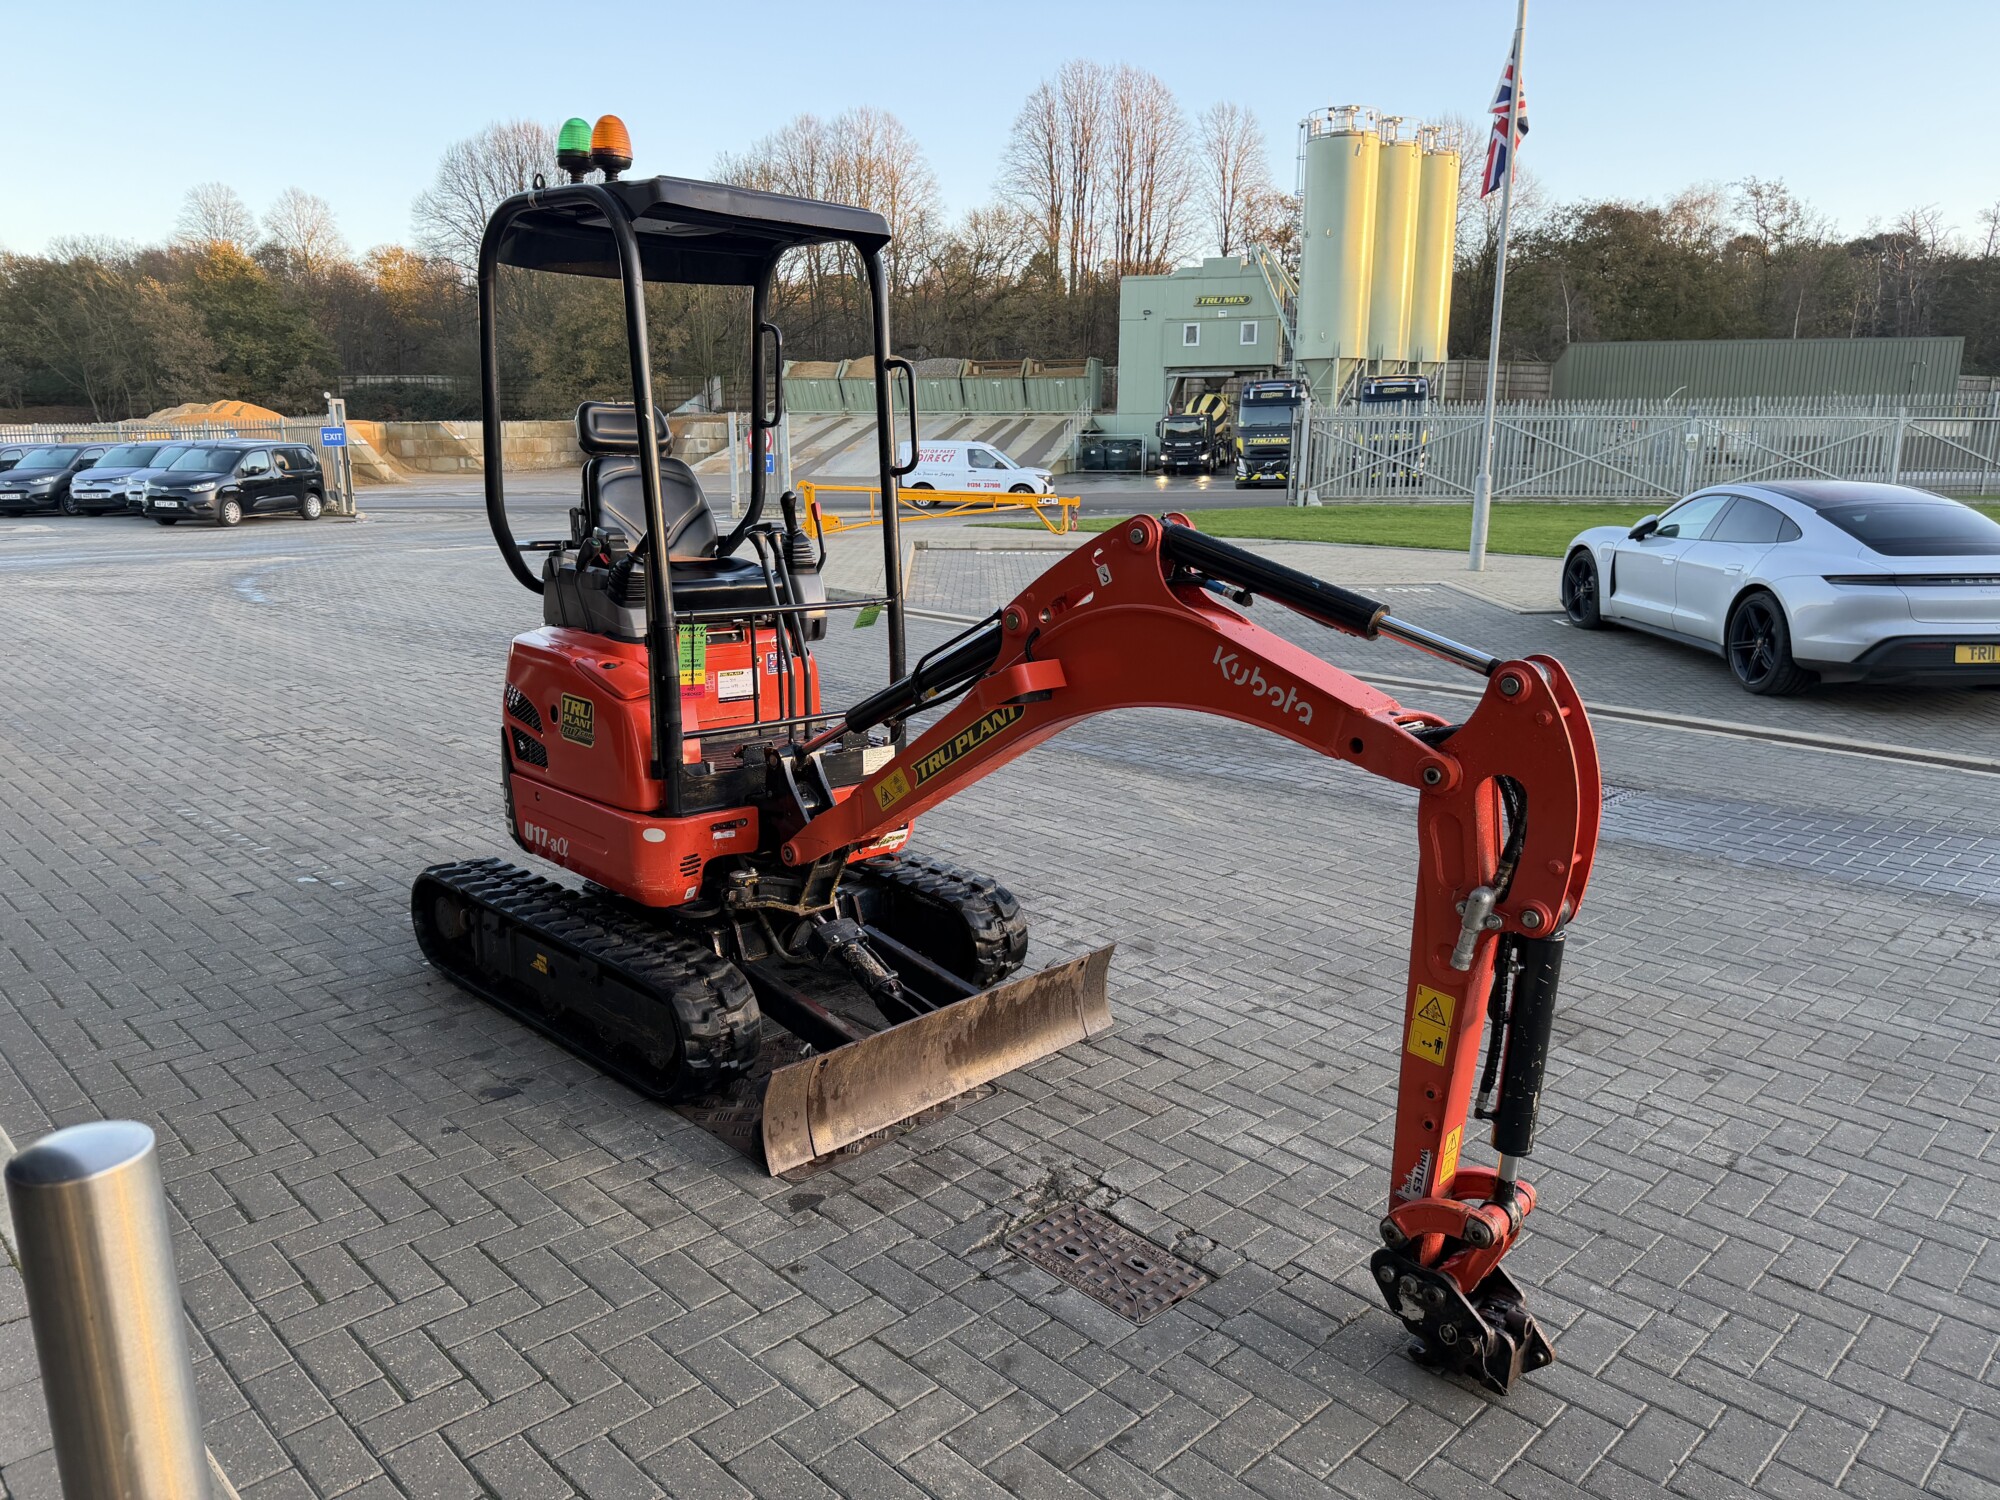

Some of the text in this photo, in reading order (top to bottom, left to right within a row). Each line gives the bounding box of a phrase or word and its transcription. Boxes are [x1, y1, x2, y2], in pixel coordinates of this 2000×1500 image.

[1201, 296, 1246, 304] TRU MIX
[324, 433, 342, 441] EXIT
[918, 454, 954, 462] DIRECT
[1968, 646, 1996, 660] TR11
[1212, 646, 1312, 726] Kubota
[564, 698, 591, 718] TRU
[564, 714, 592, 729] PLANT
[918, 744, 953, 779] TRU
[956, 706, 1016, 754] PLANT
